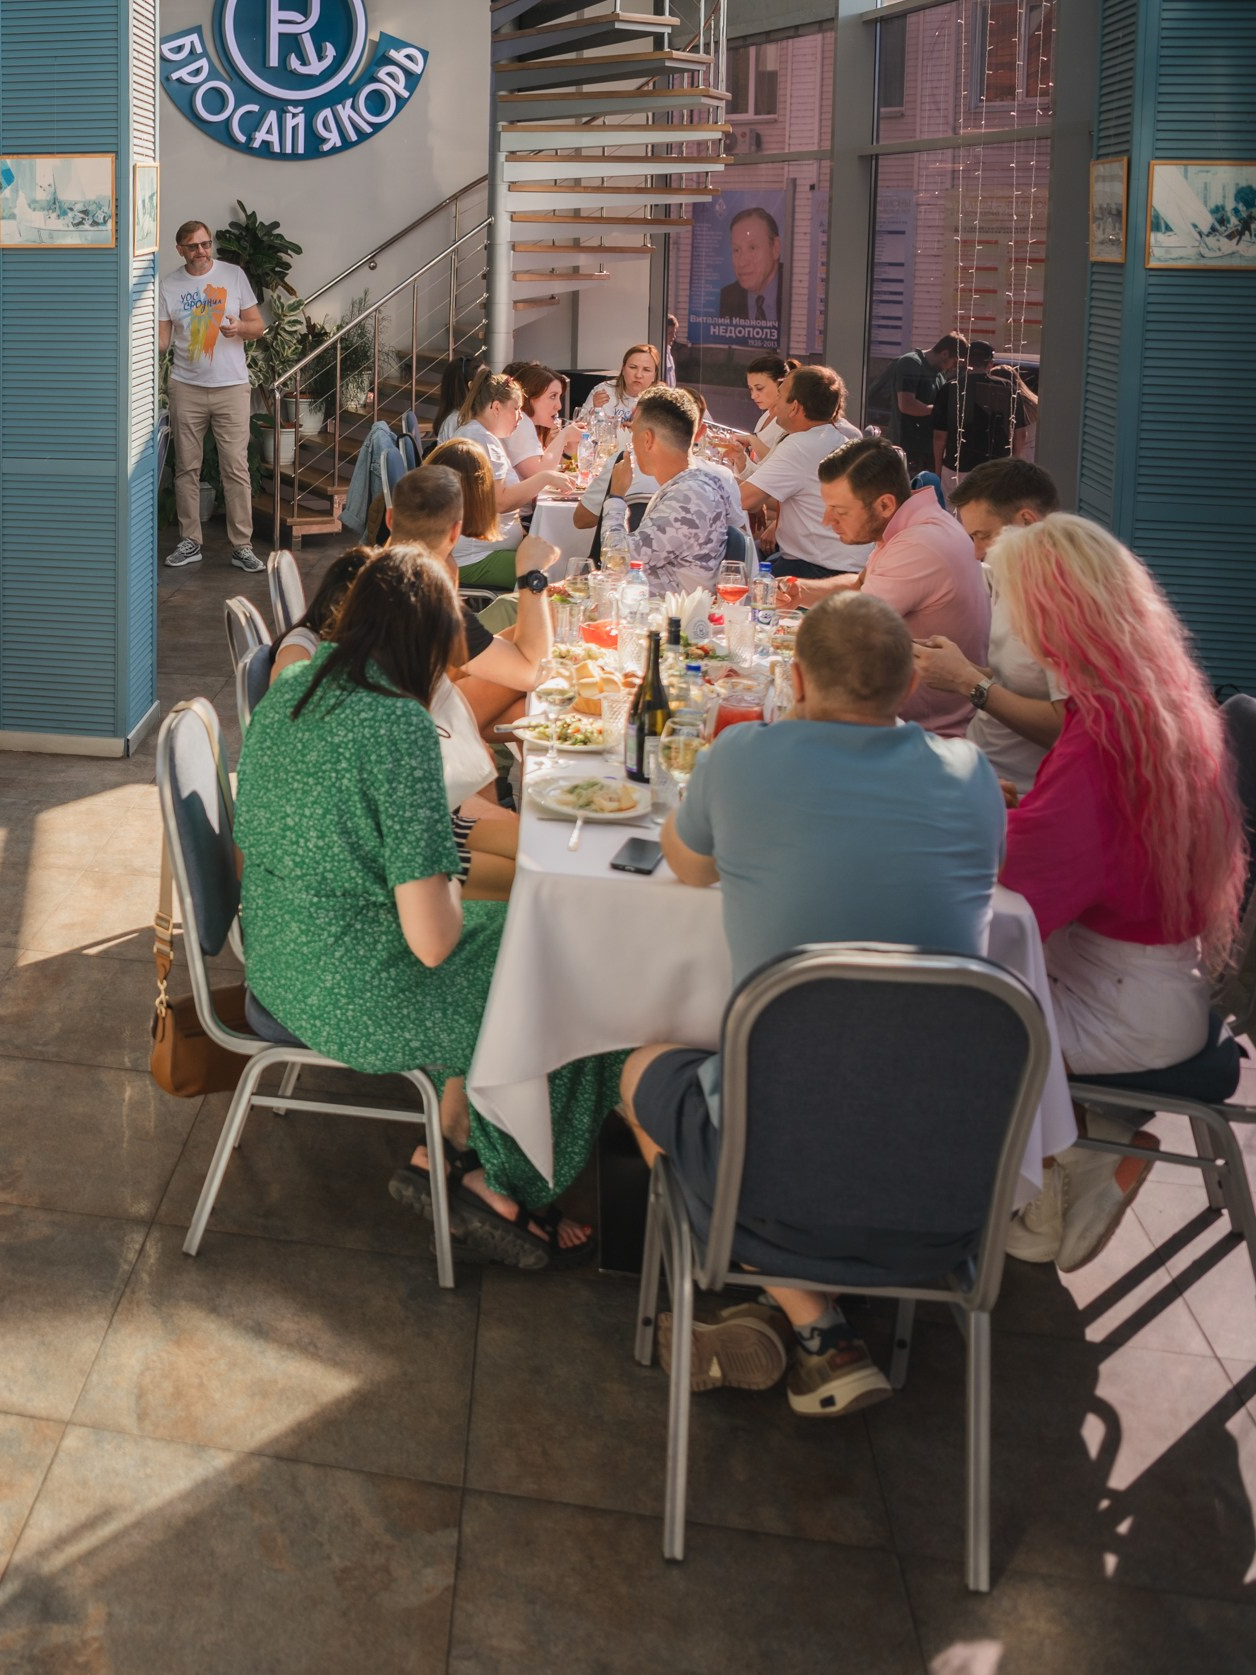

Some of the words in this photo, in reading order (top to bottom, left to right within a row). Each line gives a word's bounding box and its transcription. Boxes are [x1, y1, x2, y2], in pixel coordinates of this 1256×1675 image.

[160, 33, 304, 154] БРОСАЙ
[313, 47, 425, 152] ЯКОРЬ
[690, 315, 730, 324] Виталий
[732, 317, 779, 327] Иванович
[710, 325, 778, 339] НЕДОПОЛЗ
